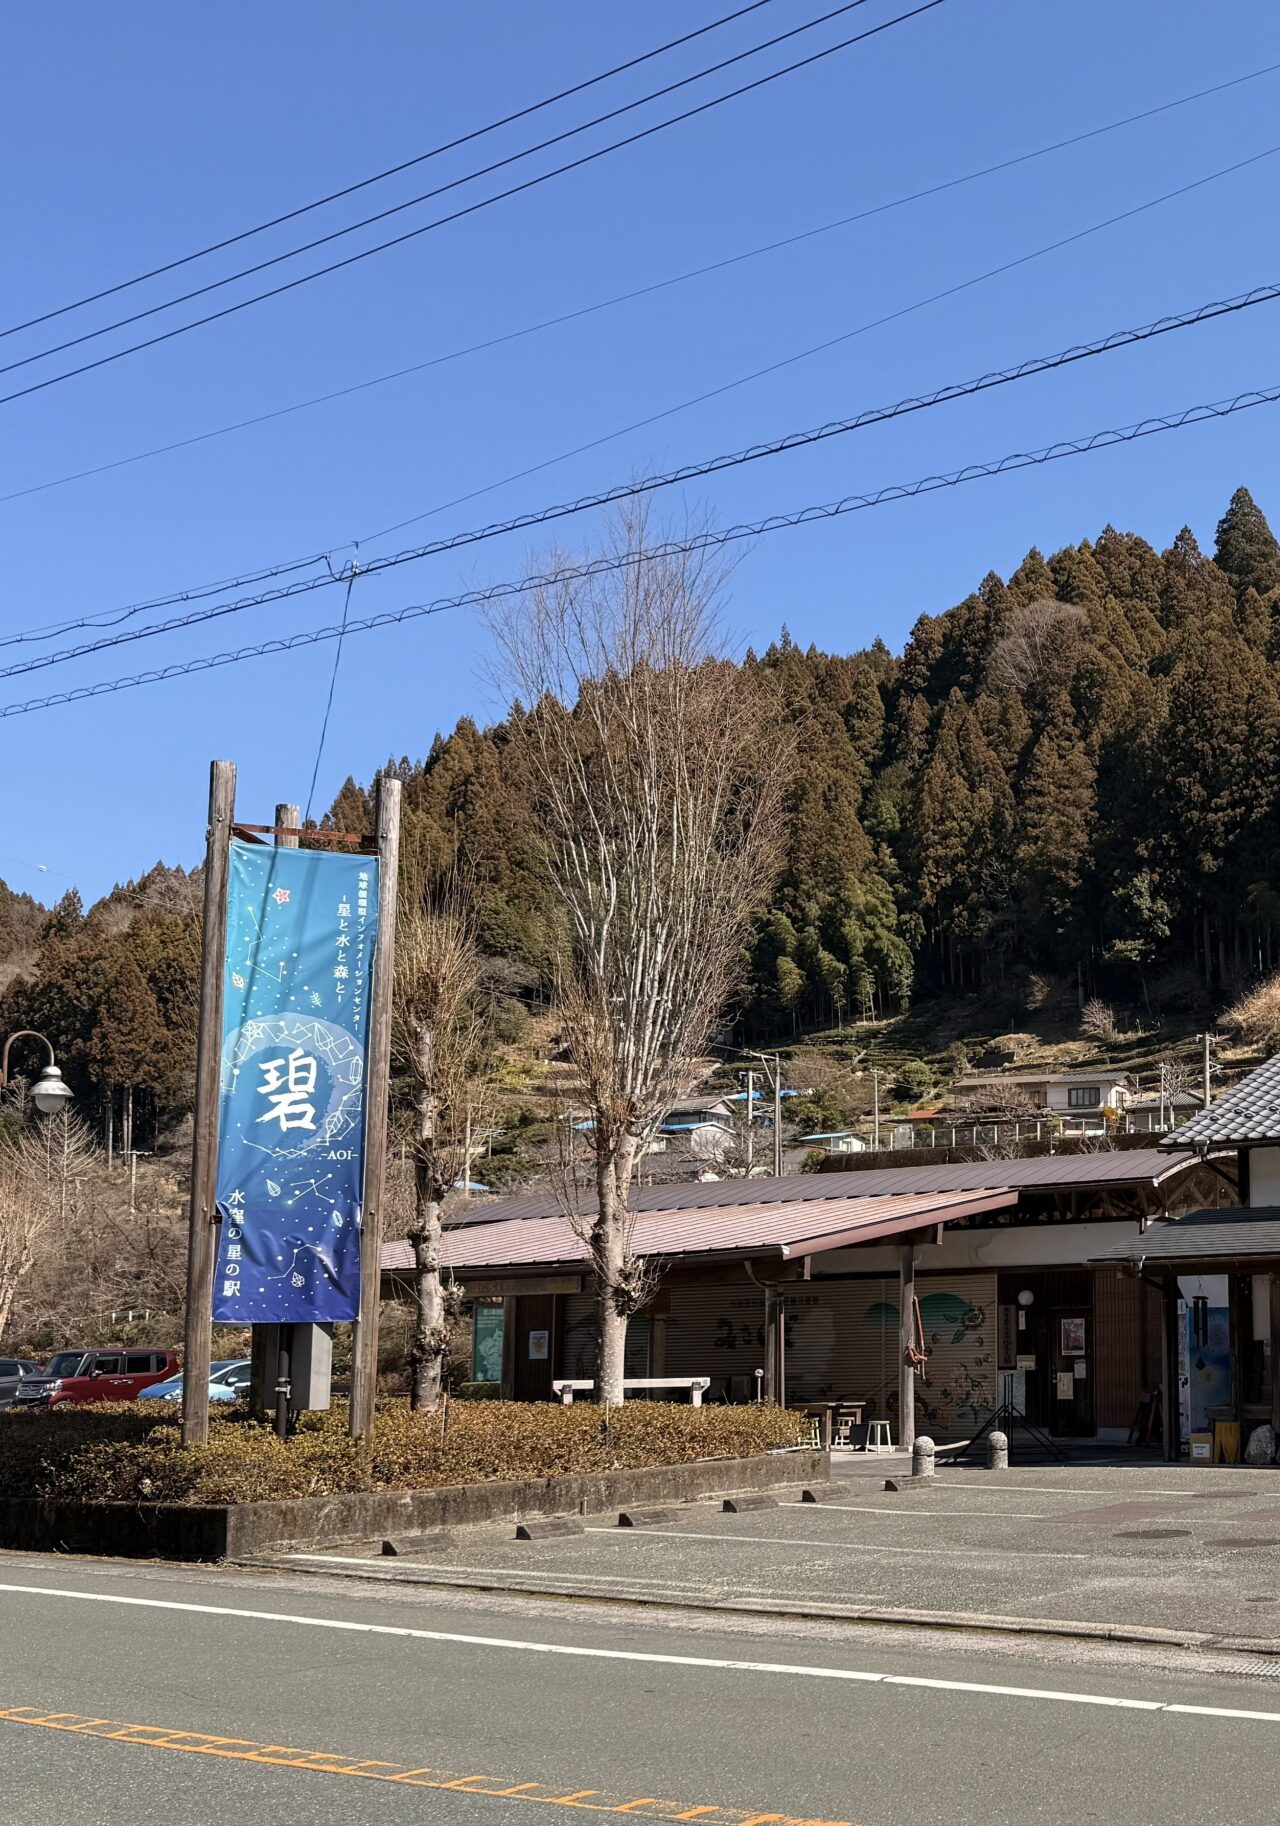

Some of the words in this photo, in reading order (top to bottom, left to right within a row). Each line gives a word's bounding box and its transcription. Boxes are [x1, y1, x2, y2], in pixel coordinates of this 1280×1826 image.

[256, 1046, 317, 1133] 碧
[222, 1190, 246, 1298] 水窪の星の駅
